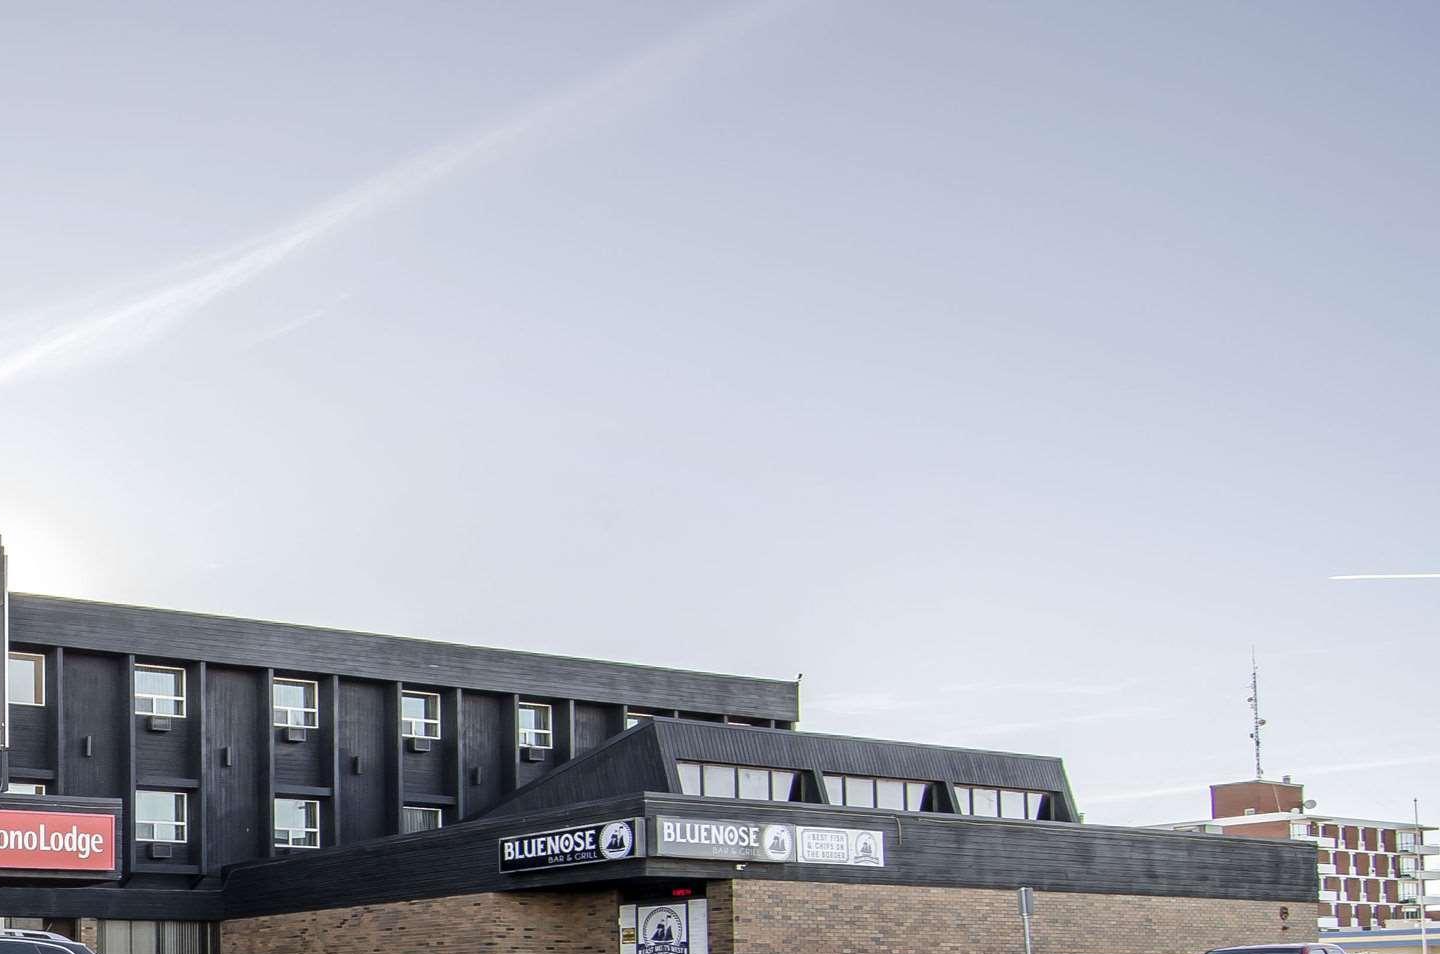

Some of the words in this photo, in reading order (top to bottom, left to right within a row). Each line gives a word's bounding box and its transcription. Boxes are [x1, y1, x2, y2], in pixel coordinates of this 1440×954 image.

[504, 829, 597, 861] BLUENOSE
[663, 821, 761, 847] BLUENOSE
[548, 856, 565, 864] BAR
[574, 851, 598, 860] GRILL
